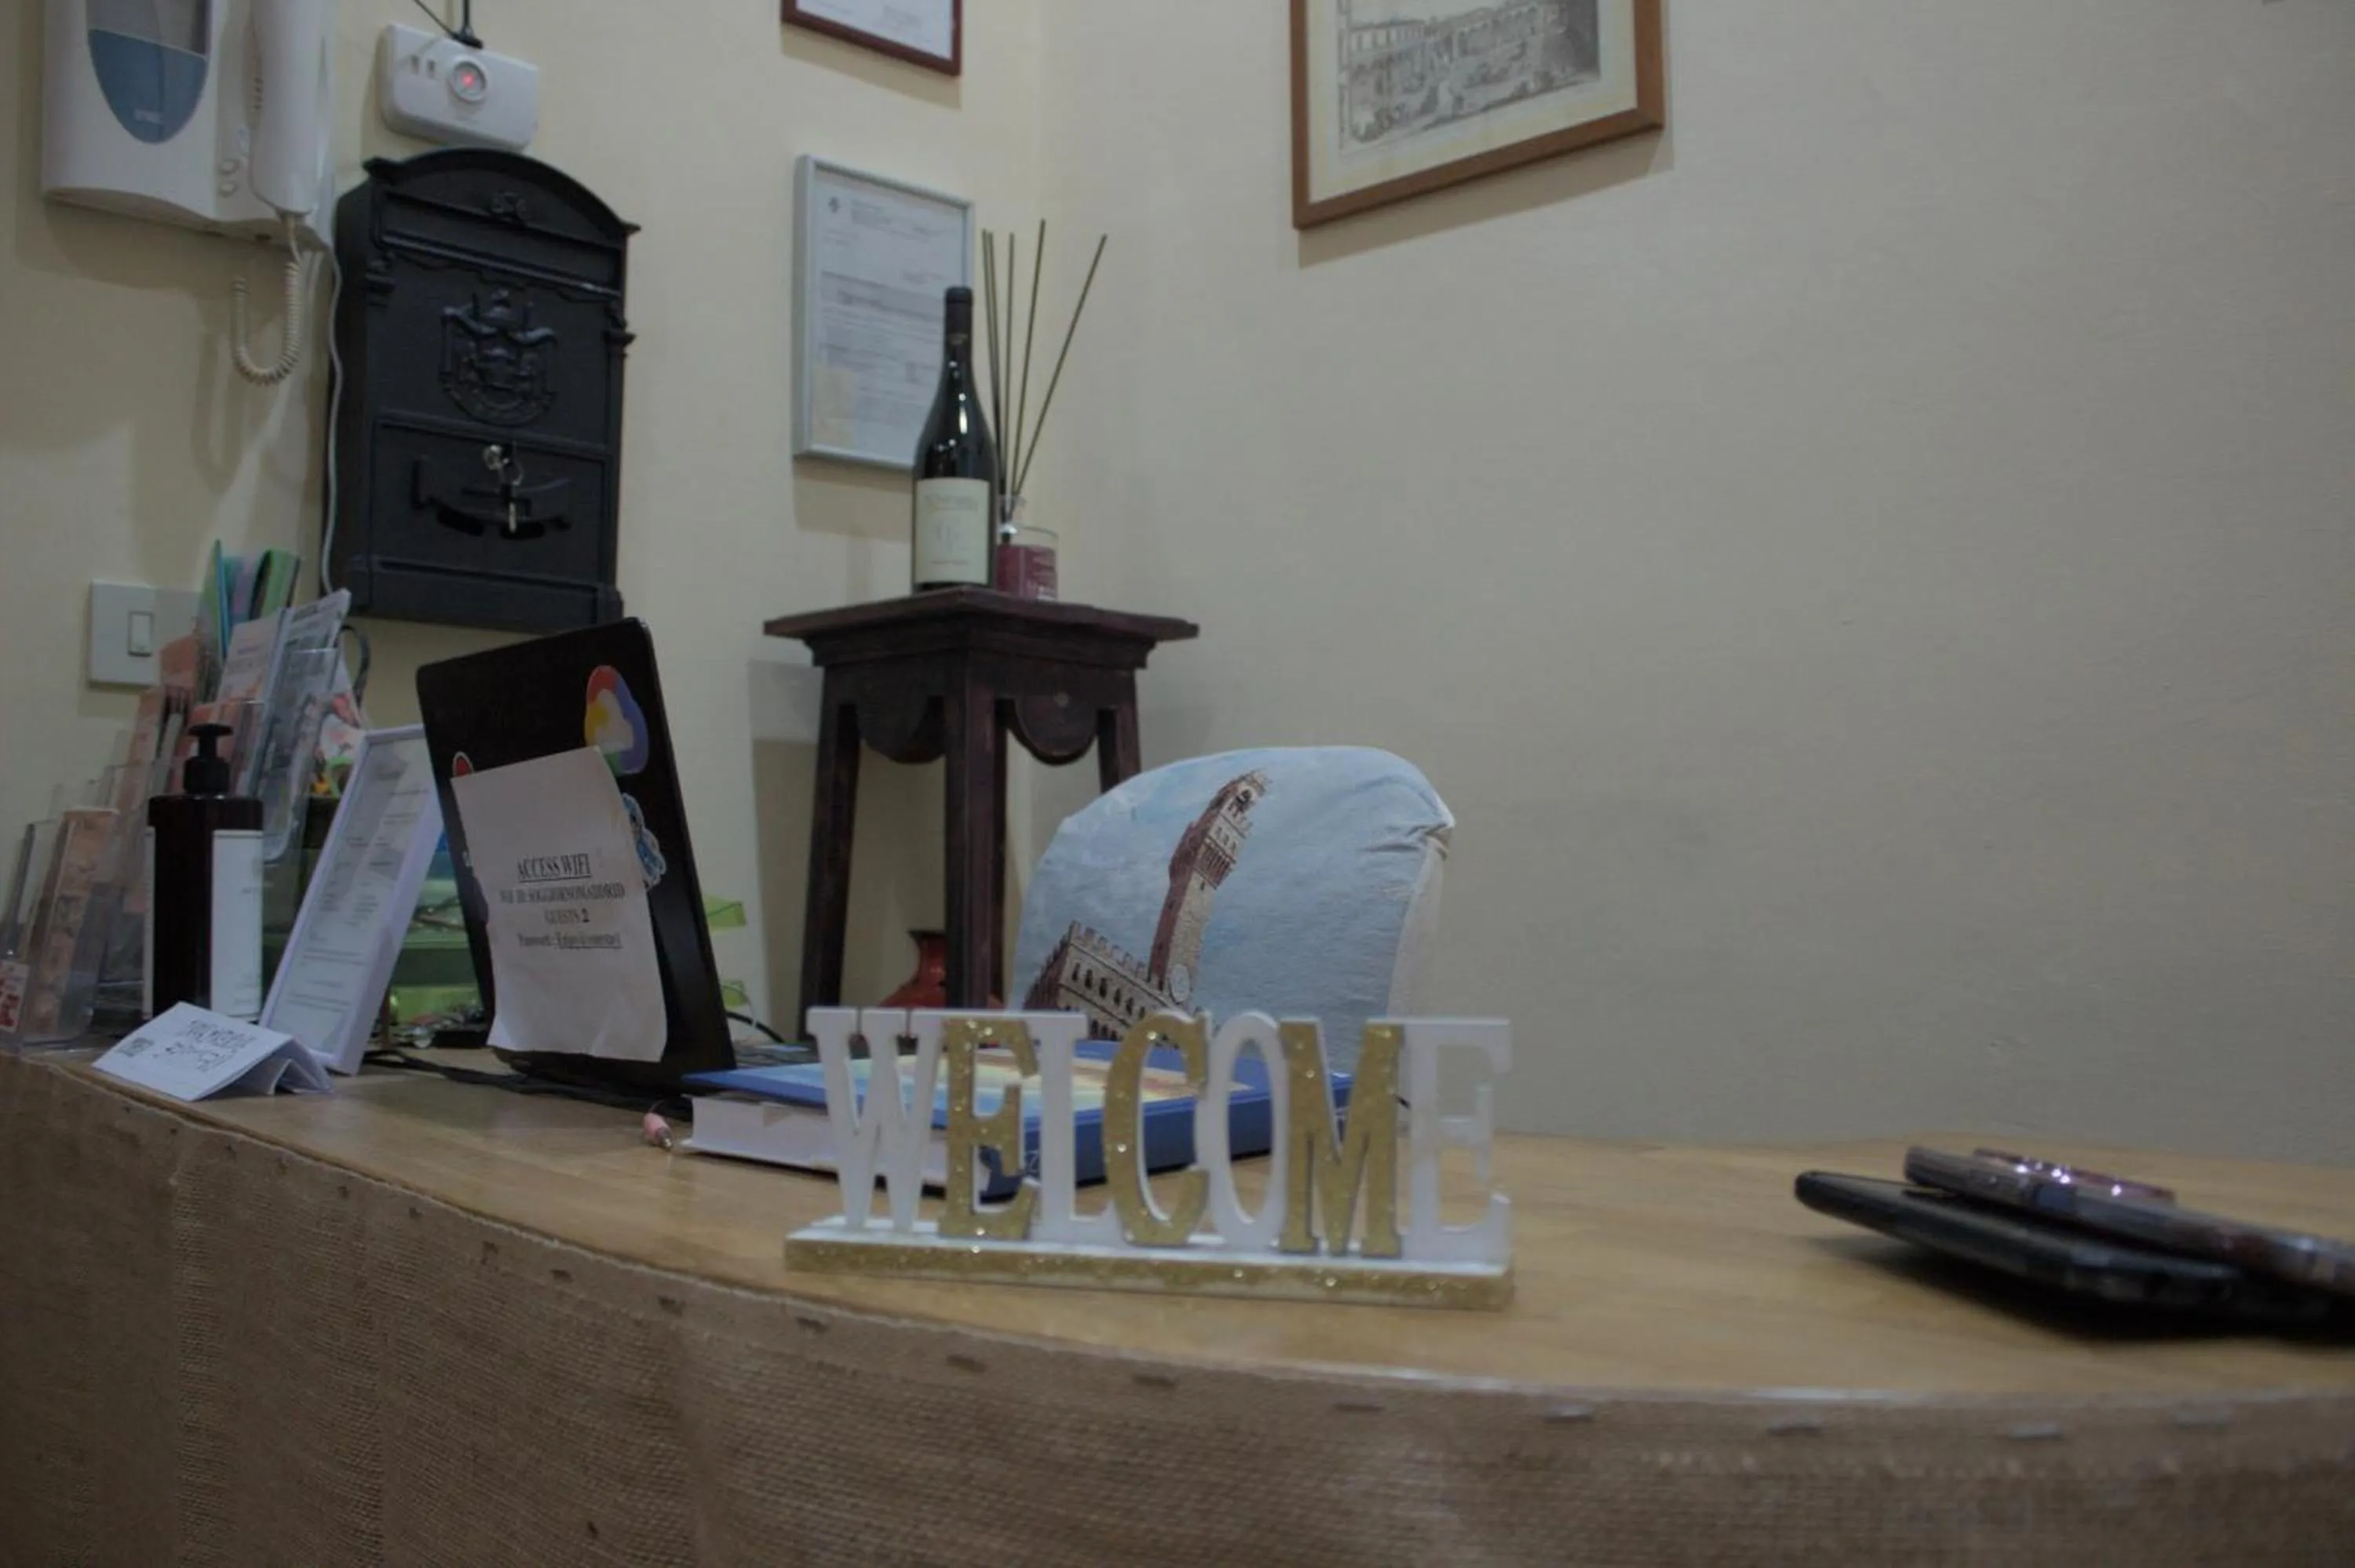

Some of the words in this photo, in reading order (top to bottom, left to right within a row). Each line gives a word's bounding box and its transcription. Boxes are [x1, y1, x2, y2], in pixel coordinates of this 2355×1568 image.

[517, 855, 560, 881] ACCESS
[560, 853, 590, 877] WIFI
[806, 1008, 1511, 1259] WELCOME
